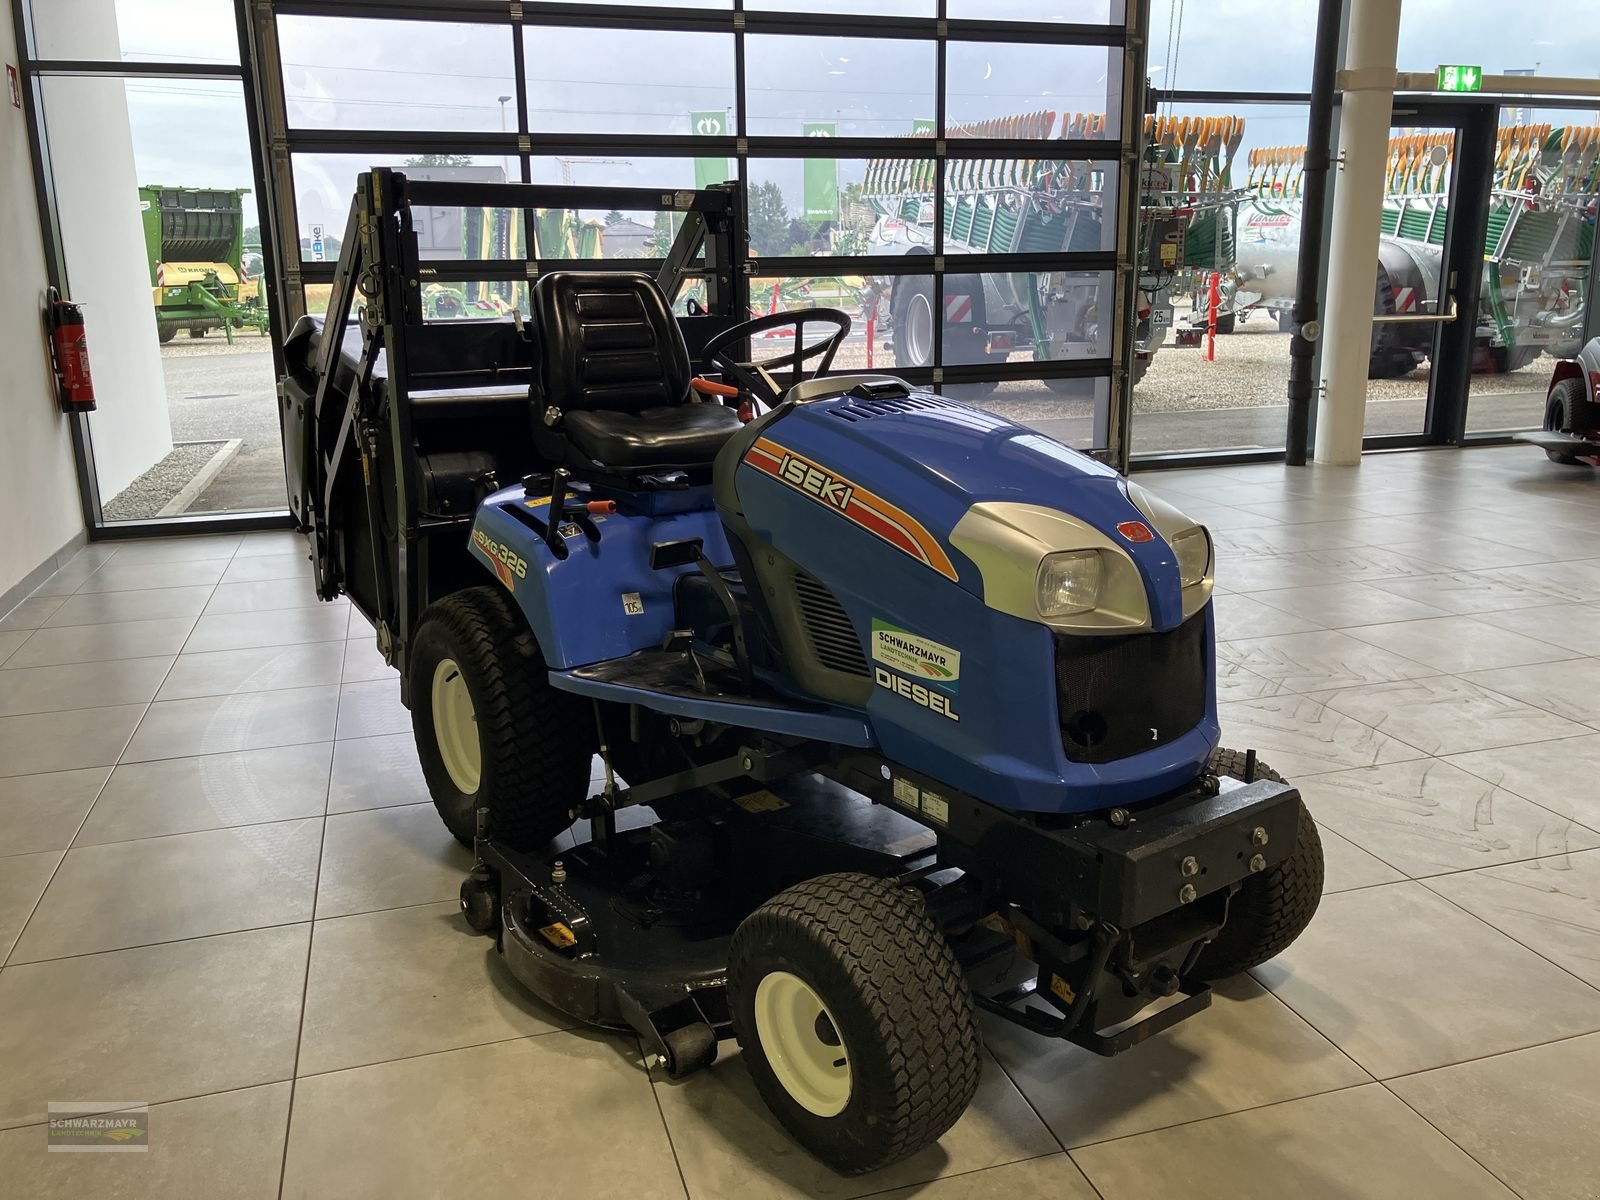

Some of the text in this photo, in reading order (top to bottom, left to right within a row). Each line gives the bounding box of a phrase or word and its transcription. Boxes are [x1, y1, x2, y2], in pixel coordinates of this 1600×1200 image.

[1153, 310, 1163, 323] 25
[778, 454, 853, 510] ISEKI
[625, 602, 639, 613] 105
[879, 631, 946, 667] SCHWARZMAYR
[880, 643, 919, 665] LANDTECHNIK
[875, 666, 960, 721] DIESEL
